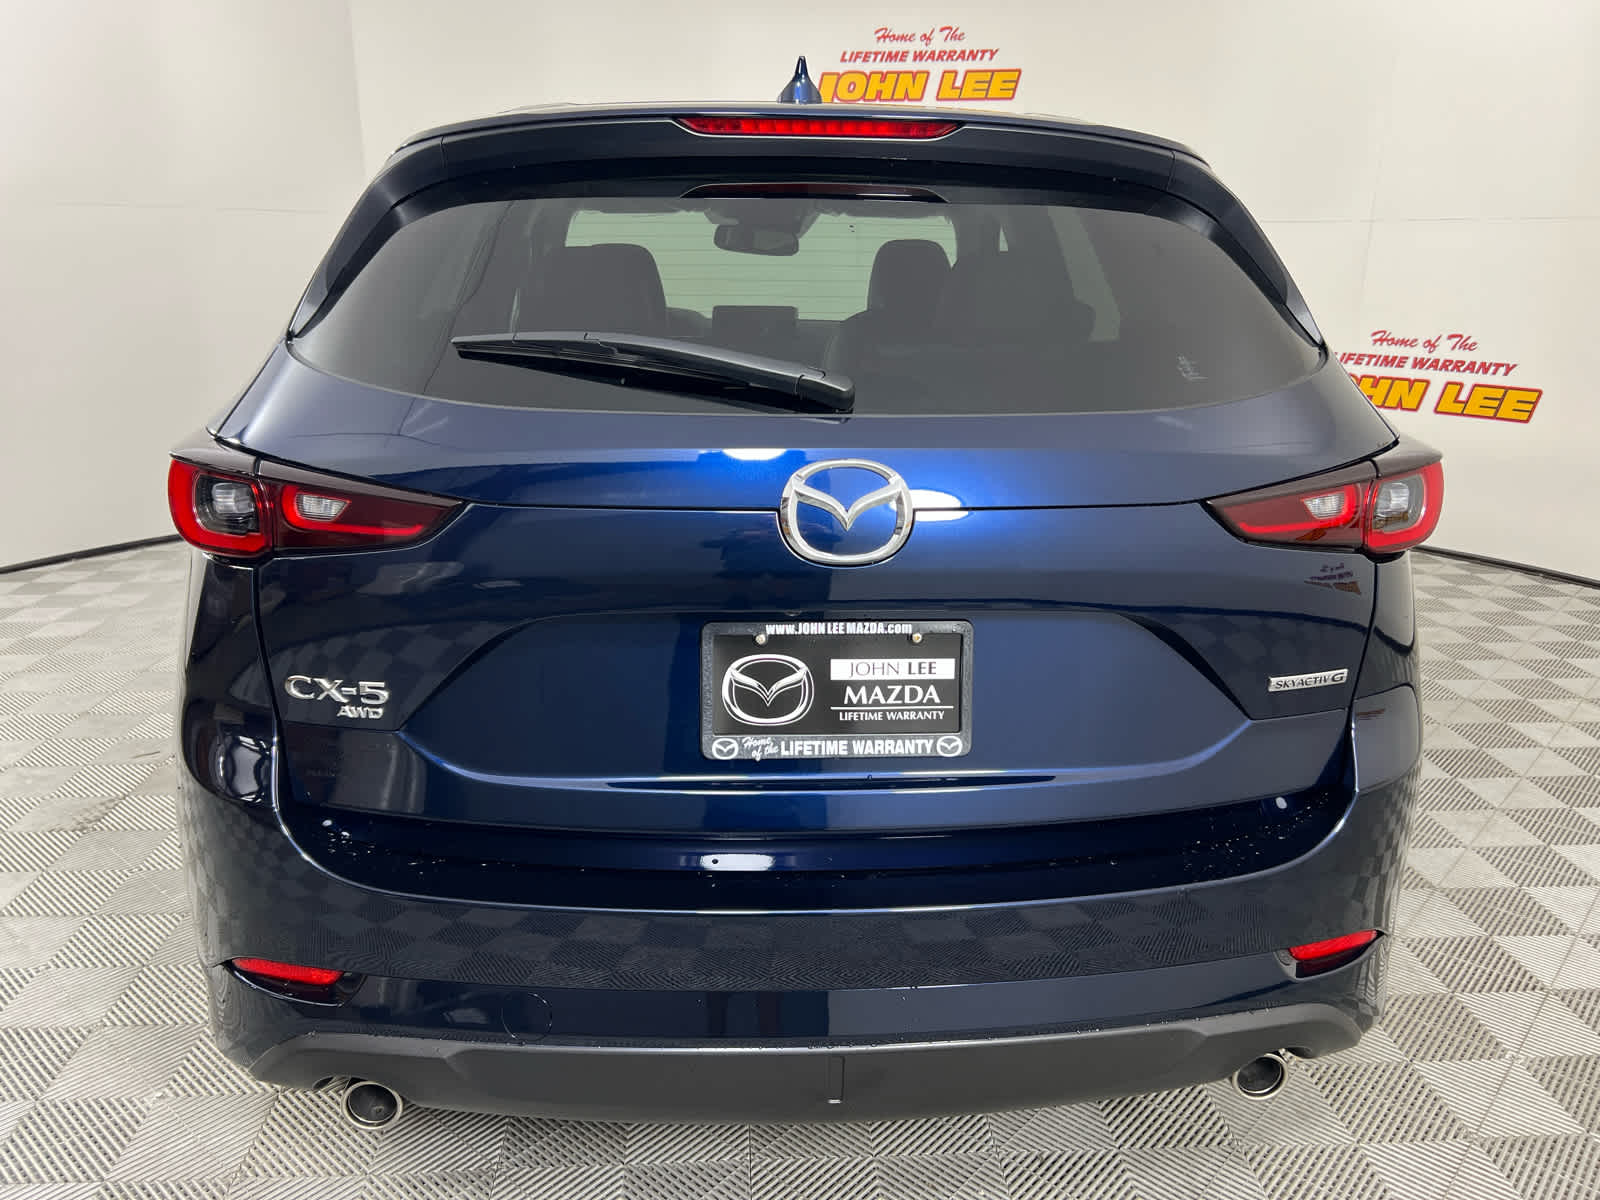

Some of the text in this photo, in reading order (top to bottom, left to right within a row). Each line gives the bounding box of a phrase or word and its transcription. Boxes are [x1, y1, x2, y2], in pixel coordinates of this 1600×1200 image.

[874, 26, 966, 47] Home of The
[840, 48, 999, 63] LIFETIME WARRANTY
[819, 68, 1021, 102] JOHN LEE
[1371, 330, 1478, 354] Home of The
[1335, 352, 1517, 377] IFETIME WARRANTY
[1433, 381, 1543, 424] LEE
[849, 662, 937, 678] JOHN LEE
[285, 675, 389, 704] CX-5
[843, 685, 941, 704] MAZDA
[337, 705, 383, 719] AWD
[839, 710, 945, 721] LIFETIME WARRANTY
[742, 736, 772, 749] Home
[752, 742, 779, 762] of the
[781, 739, 934, 756] LIFETIME WARRANTY
